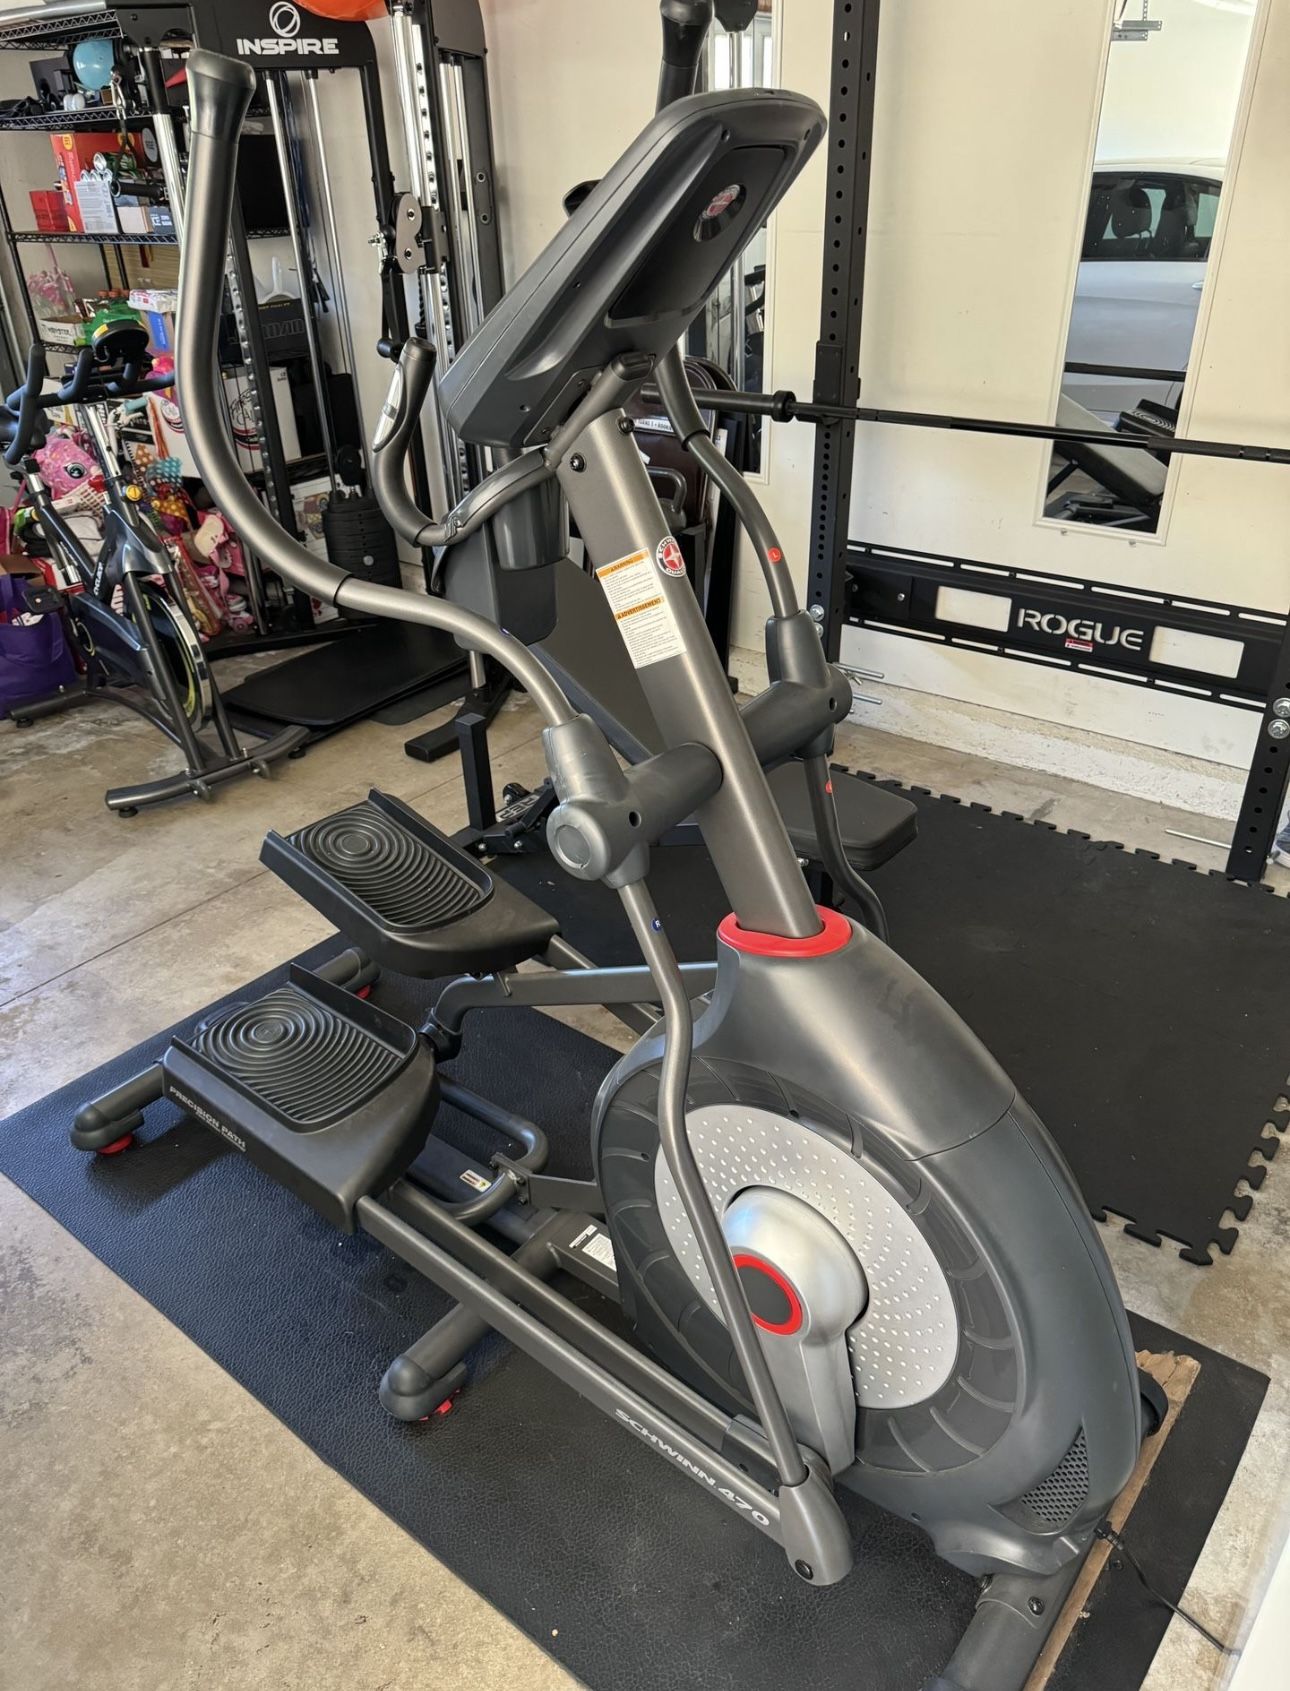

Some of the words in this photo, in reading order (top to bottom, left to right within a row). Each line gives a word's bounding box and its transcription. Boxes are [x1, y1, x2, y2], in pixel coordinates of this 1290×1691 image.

[236, 38, 340, 55] INSPIRE
[1017, 608, 1145, 651] ROGUE
[169, 1085, 221, 1128] PRECISION
[221, 1125, 247, 1148] PATH
[615, 1408, 716, 1487] SCHWINN
[718, 1487, 770, 1527] 470
